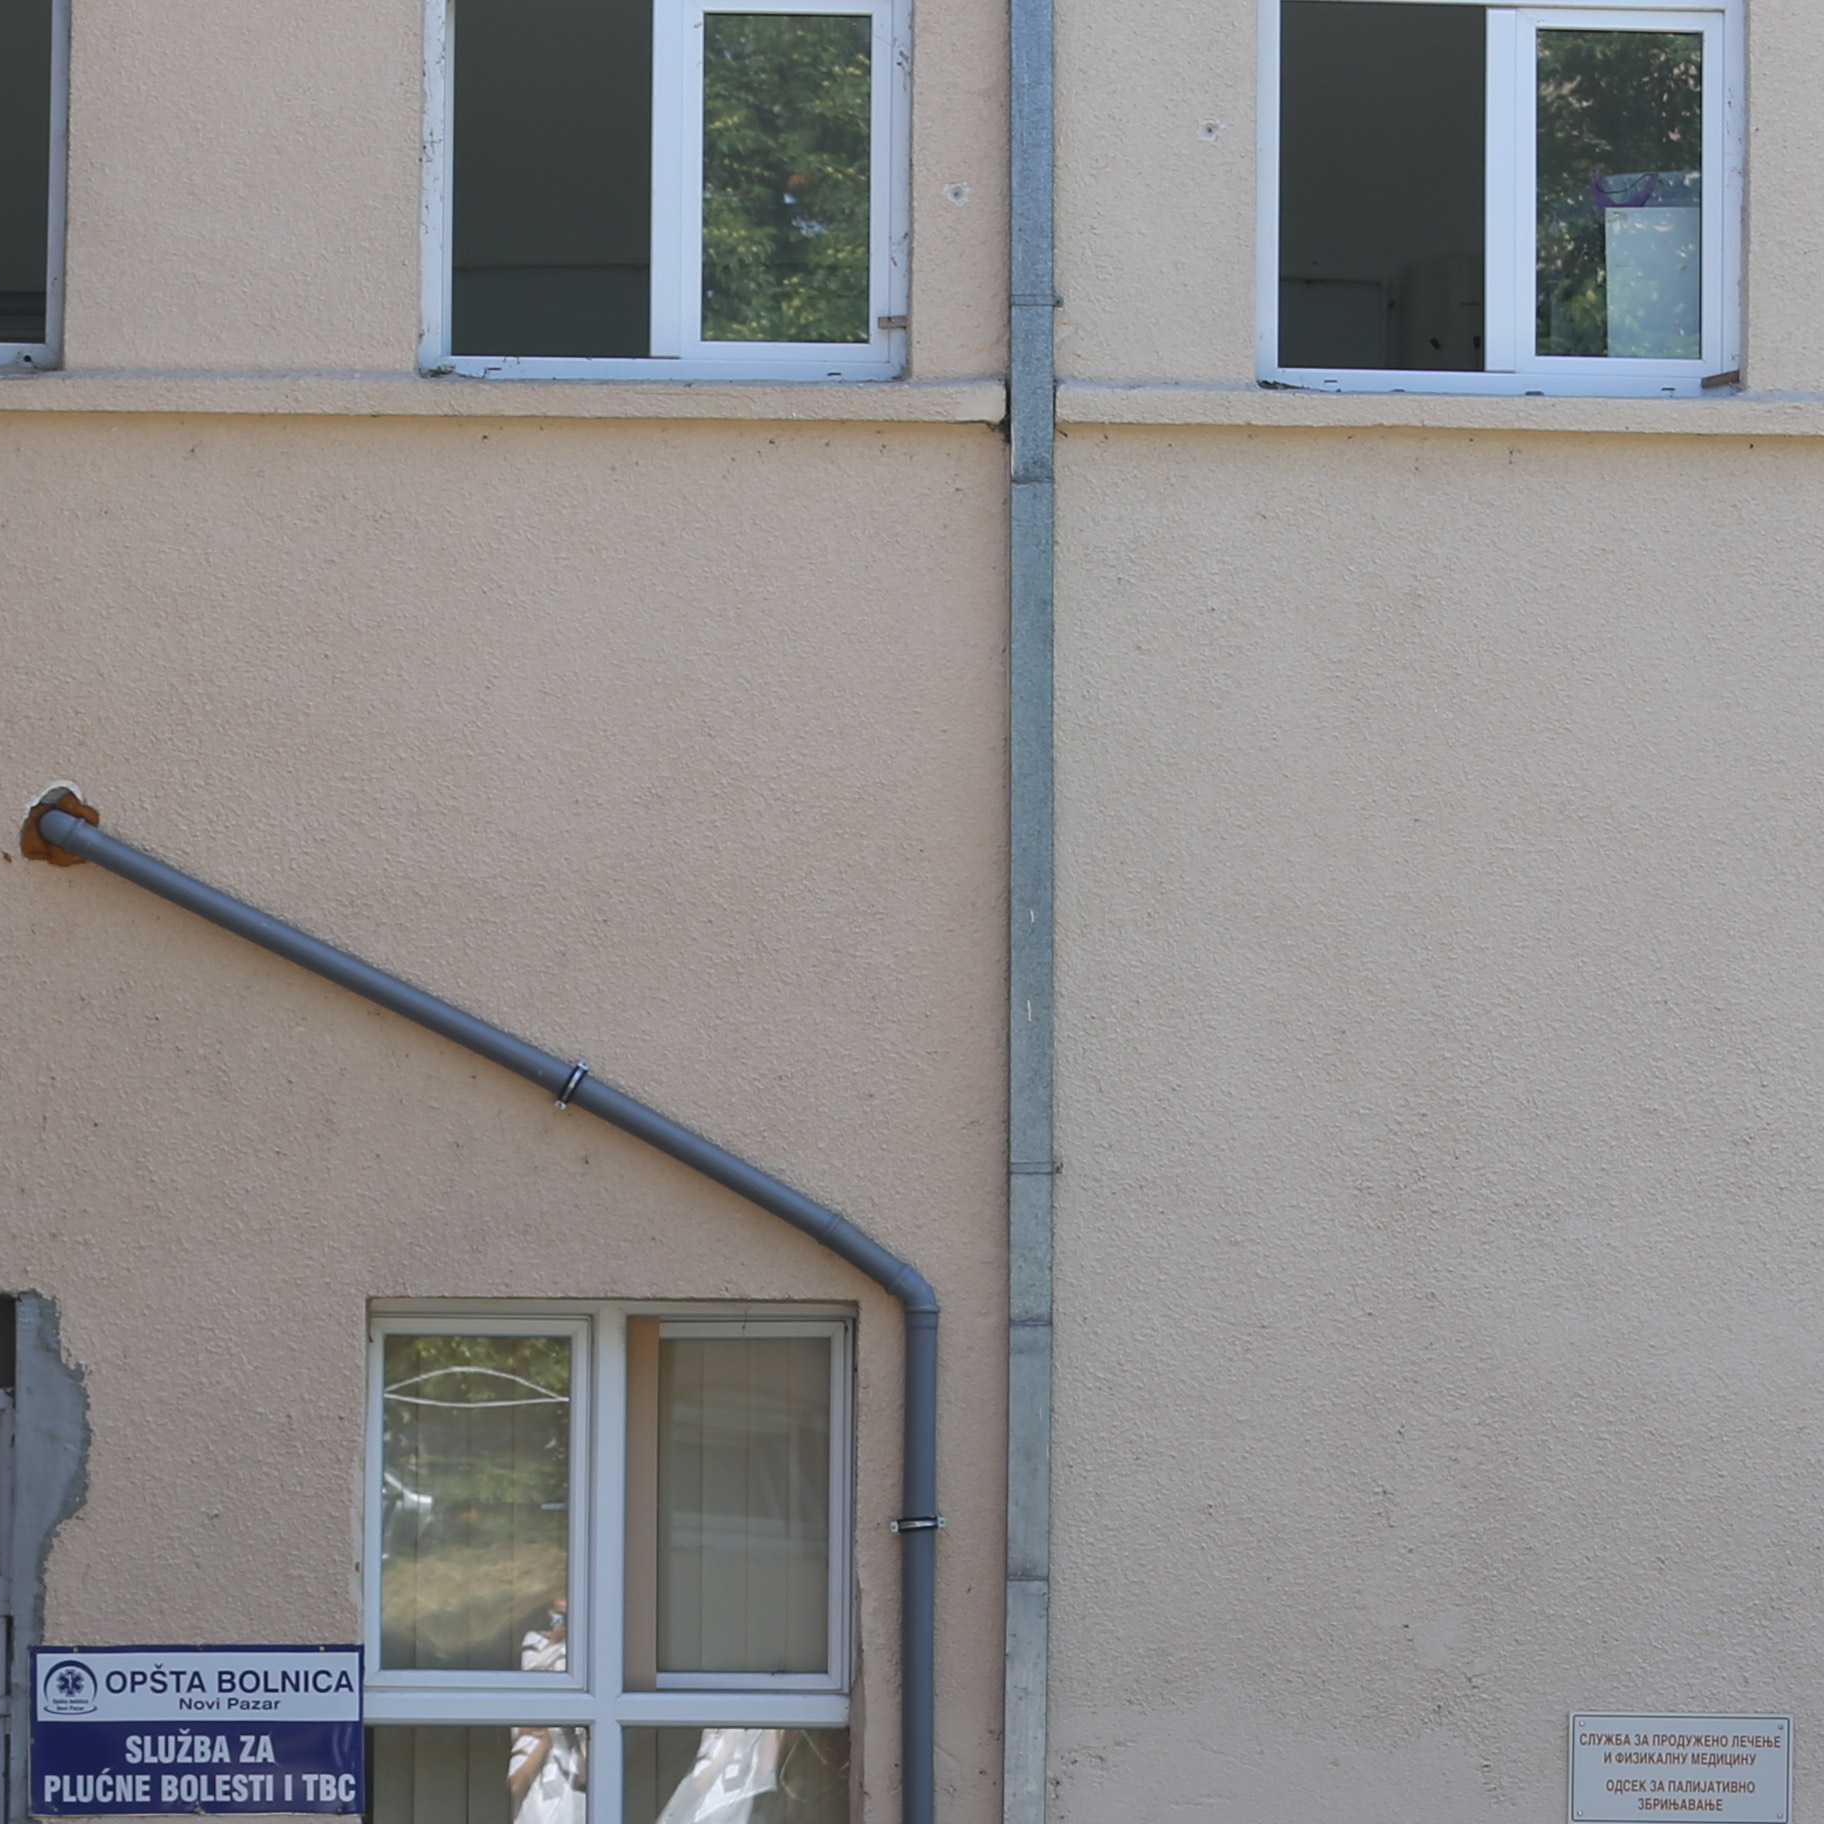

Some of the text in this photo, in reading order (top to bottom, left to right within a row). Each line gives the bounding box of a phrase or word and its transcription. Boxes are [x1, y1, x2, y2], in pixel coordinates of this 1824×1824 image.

[105, 1663, 355, 1694] OPŠTA BOLNICA
[179, 1697, 281, 1711] Novi Pazar
[125, 1727, 277, 1764] SLUŽBA ZA
[1579, 1732, 1782, 1750] СЛУЖБА ЗА ПРОДУЖЕНО ЛЕЧЕЊЕ
[1603, 1751, 1757, 1769] И ФИЗИКАЛНУ МЕДИЦИНУ
[44, 1767, 356, 1803] PLUĆNE BOLESTI I TBC
[1605, 1778, 1756, 1796] ОДСЕК ЗА ПАЛИЈАТИВНО
[1637, 1797, 1724, 1812] ЗБРИЊАВАЊЕ
